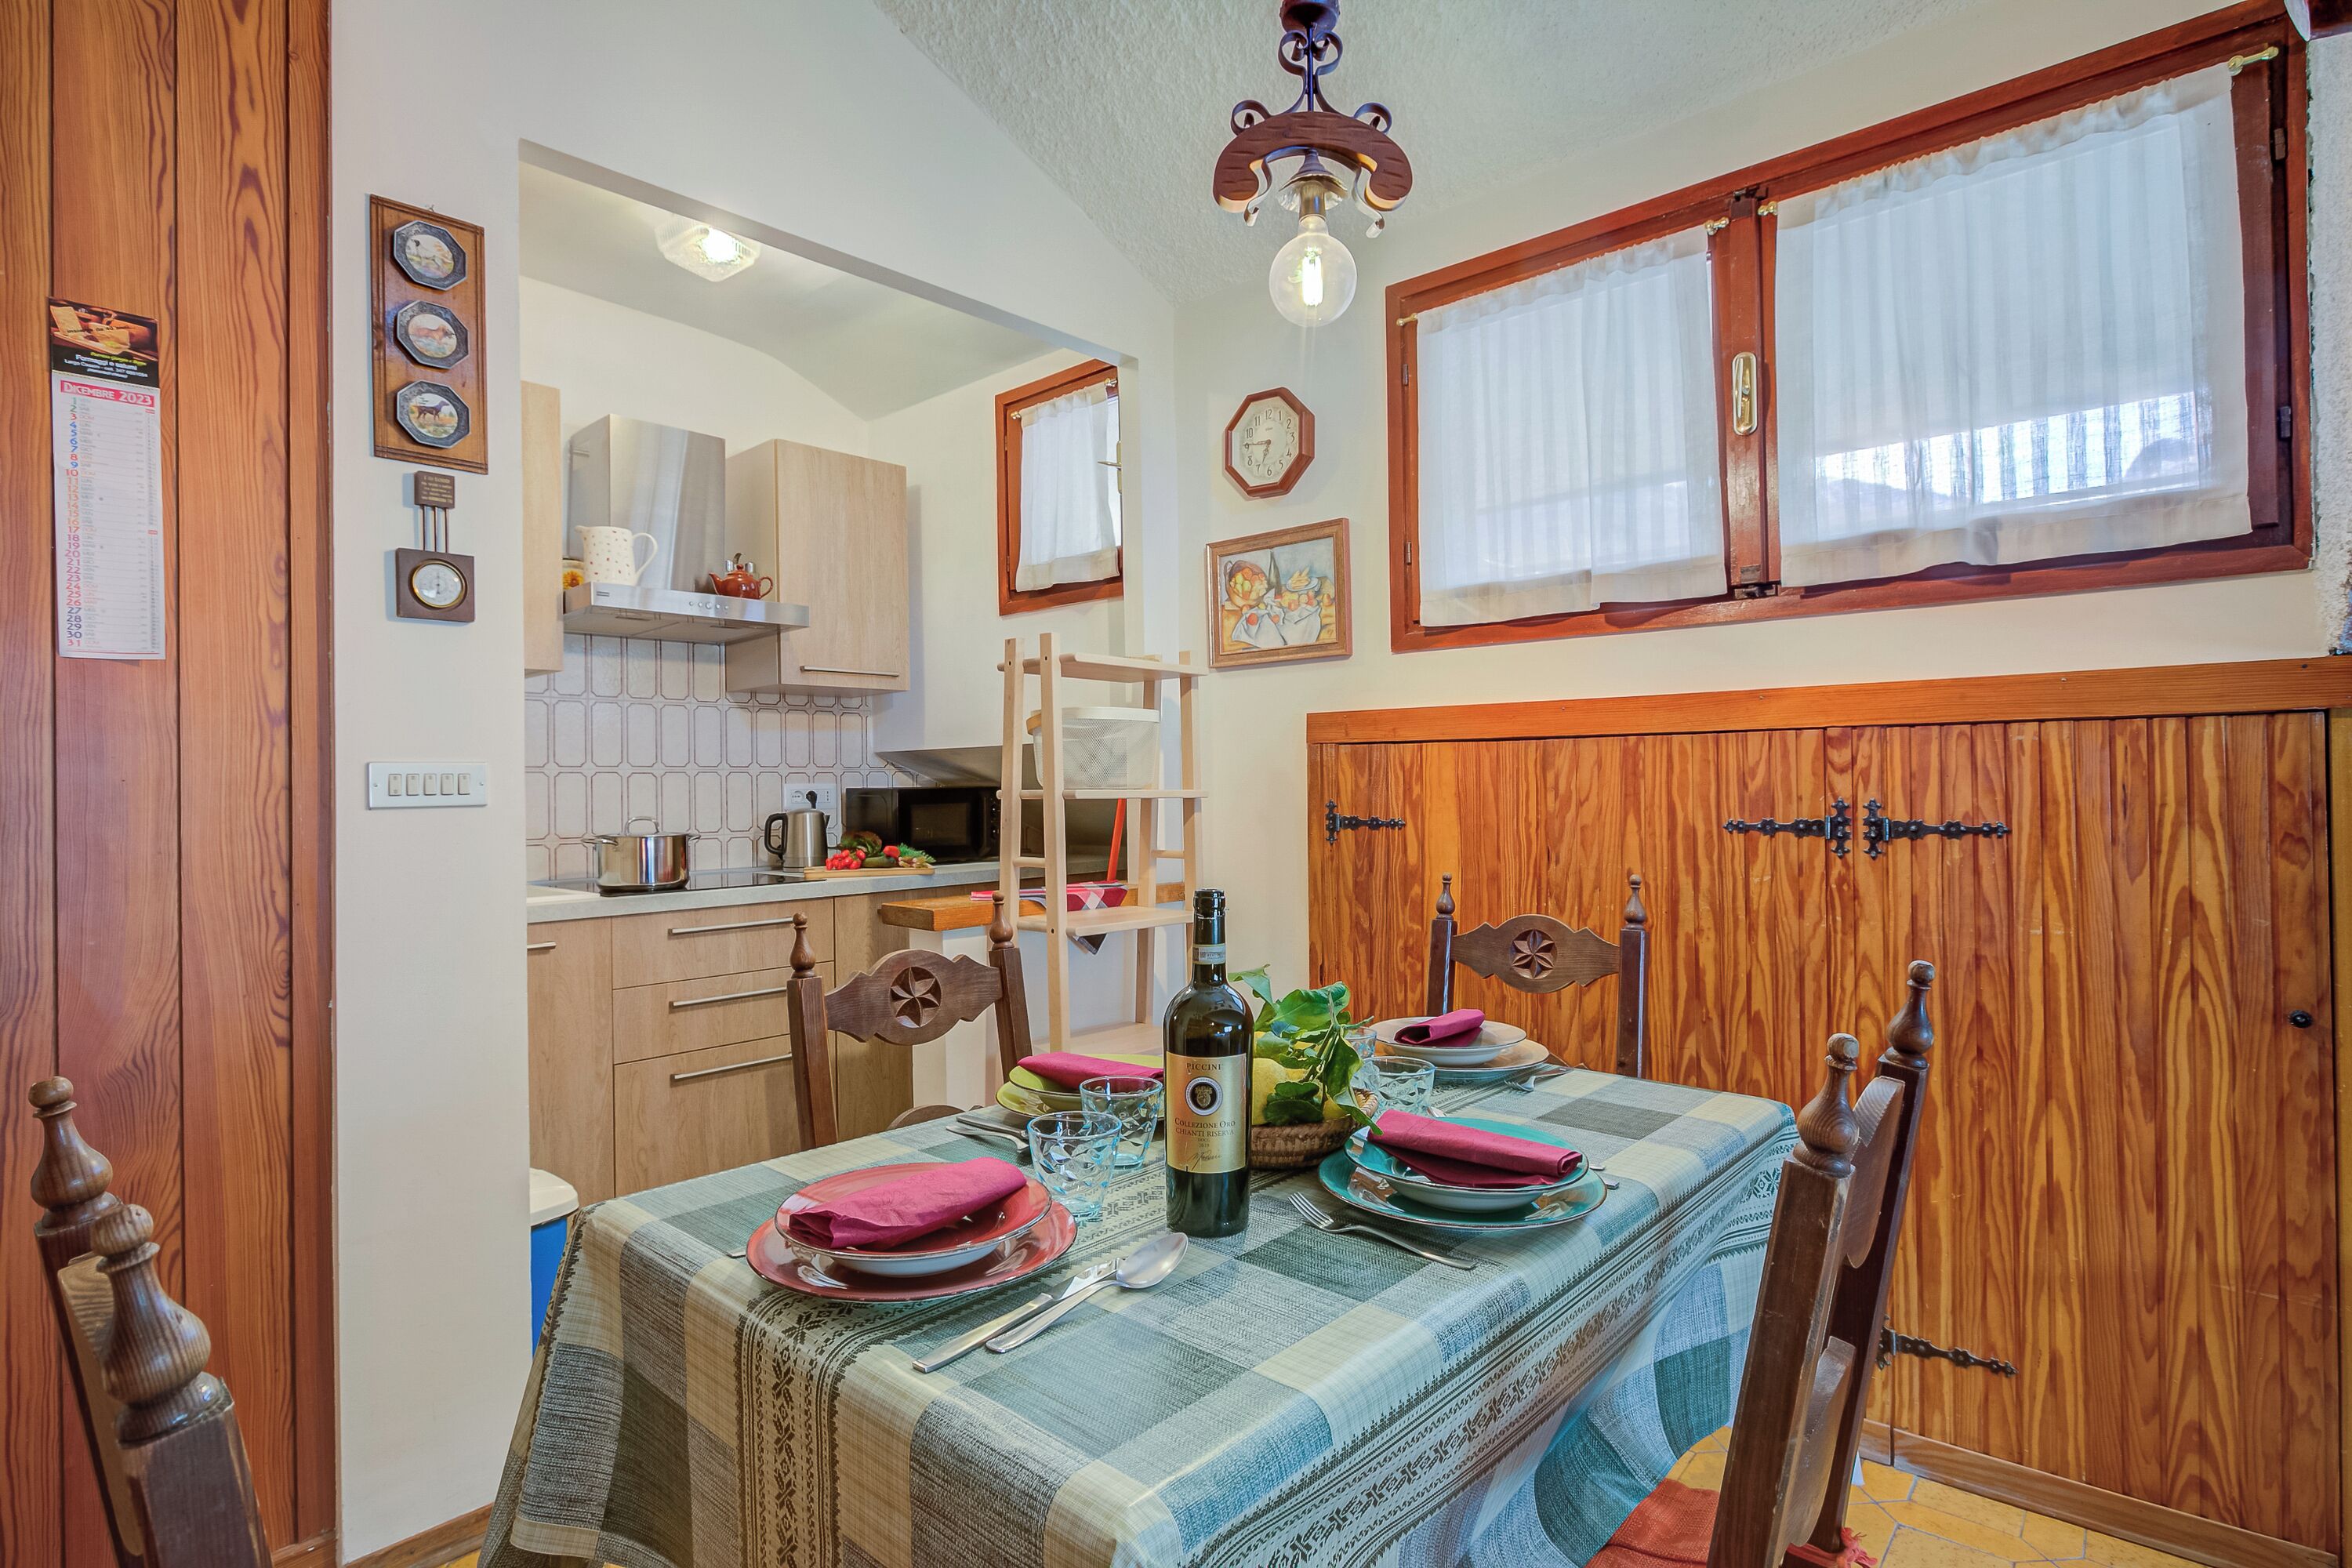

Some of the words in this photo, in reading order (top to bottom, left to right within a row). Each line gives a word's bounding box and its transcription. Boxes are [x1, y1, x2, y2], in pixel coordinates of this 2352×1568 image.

[64, 383, 114, 398] DICEMBRE
[119, 392, 151, 405] 2023
[1265, 409, 1272, 420] 12
[1279, 410, 1282, 421] 1
[1254, 416, 1261, 426] 11
[1287, 419, 1291, 430] 2
[1246, 428, 1254, 438] 10
[1290, 431, 1295, 443] 3
[1286, 448, 1292, 458] 4
[1247, 456, 1253, 466] 8
[1279, 459, 1283, 470] 5
[1256, 464, 1261, 474] 7
[1267, 466, 1272, 476] 6
[67, 566, 82, 575] 22
[66, 582, 81, 590] 24
[67, 630, 82, 639] 30
[1186, 1062, 1221, 1073] PICCINI
[1176, 1127, 1204, 1137] CHIANTI
